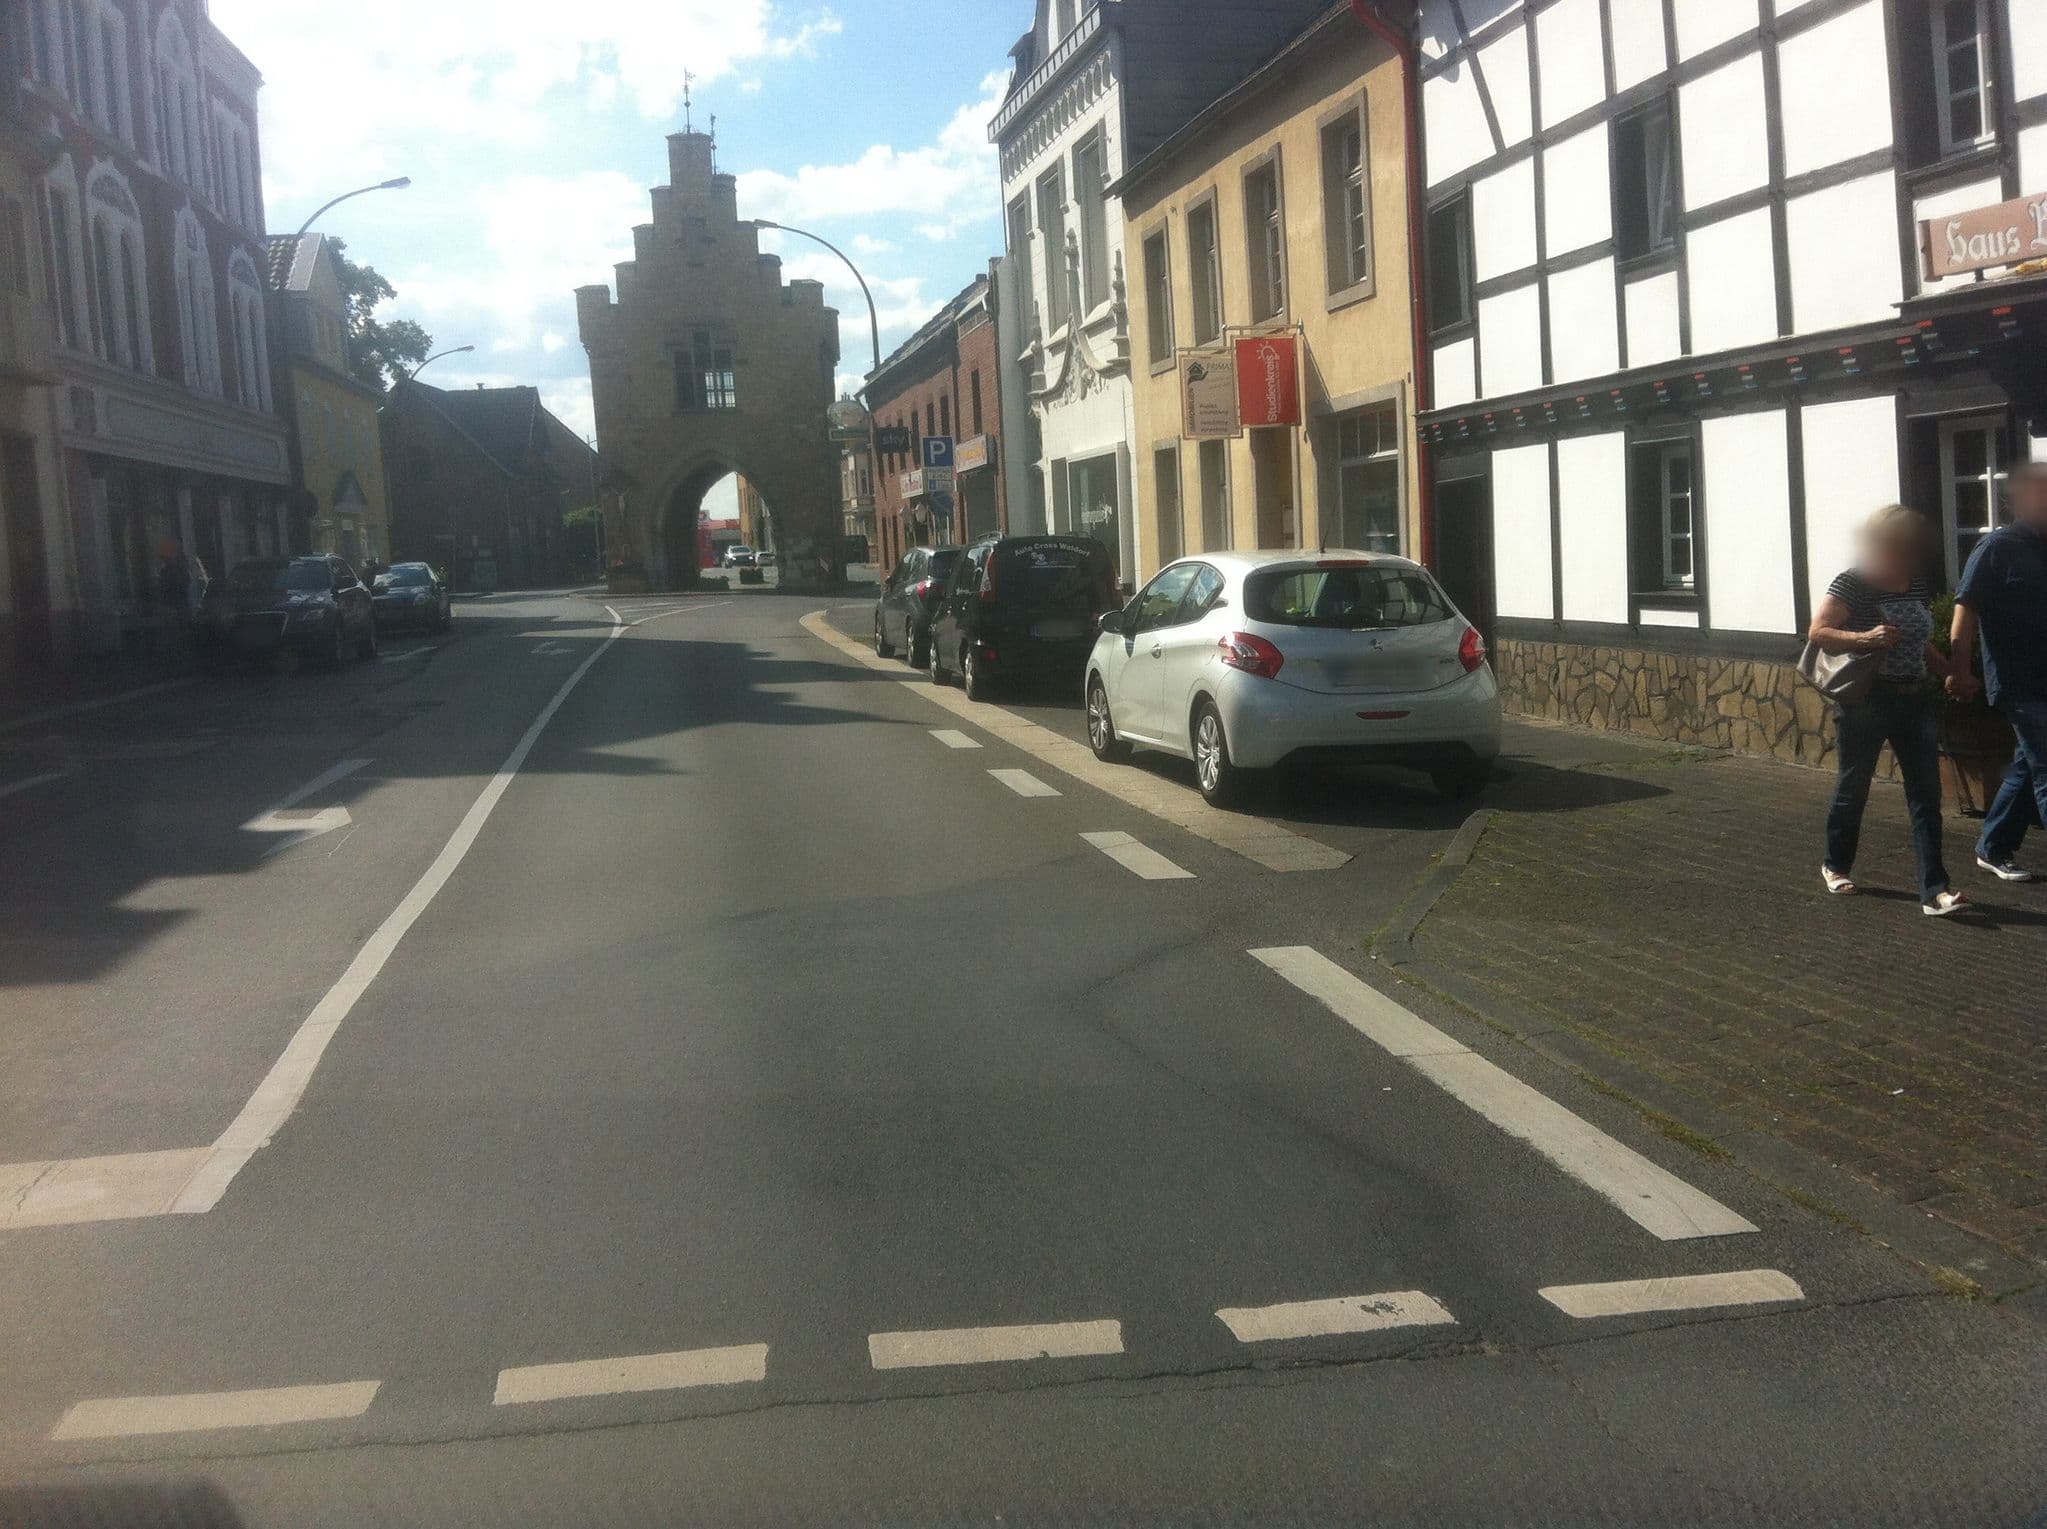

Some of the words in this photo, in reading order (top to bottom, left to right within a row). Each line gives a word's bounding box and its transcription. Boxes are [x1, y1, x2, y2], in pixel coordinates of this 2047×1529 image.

[1946, 220, 2021, 266] Haus
[1264, 354, 1278, 422] Studienkreis
[881, 431, 905, 448] sky
[930, 441, 946, 464] P
[1014, 545, 1033, 557] Auto
[1058, 542, 1090, 557] Waldorf
